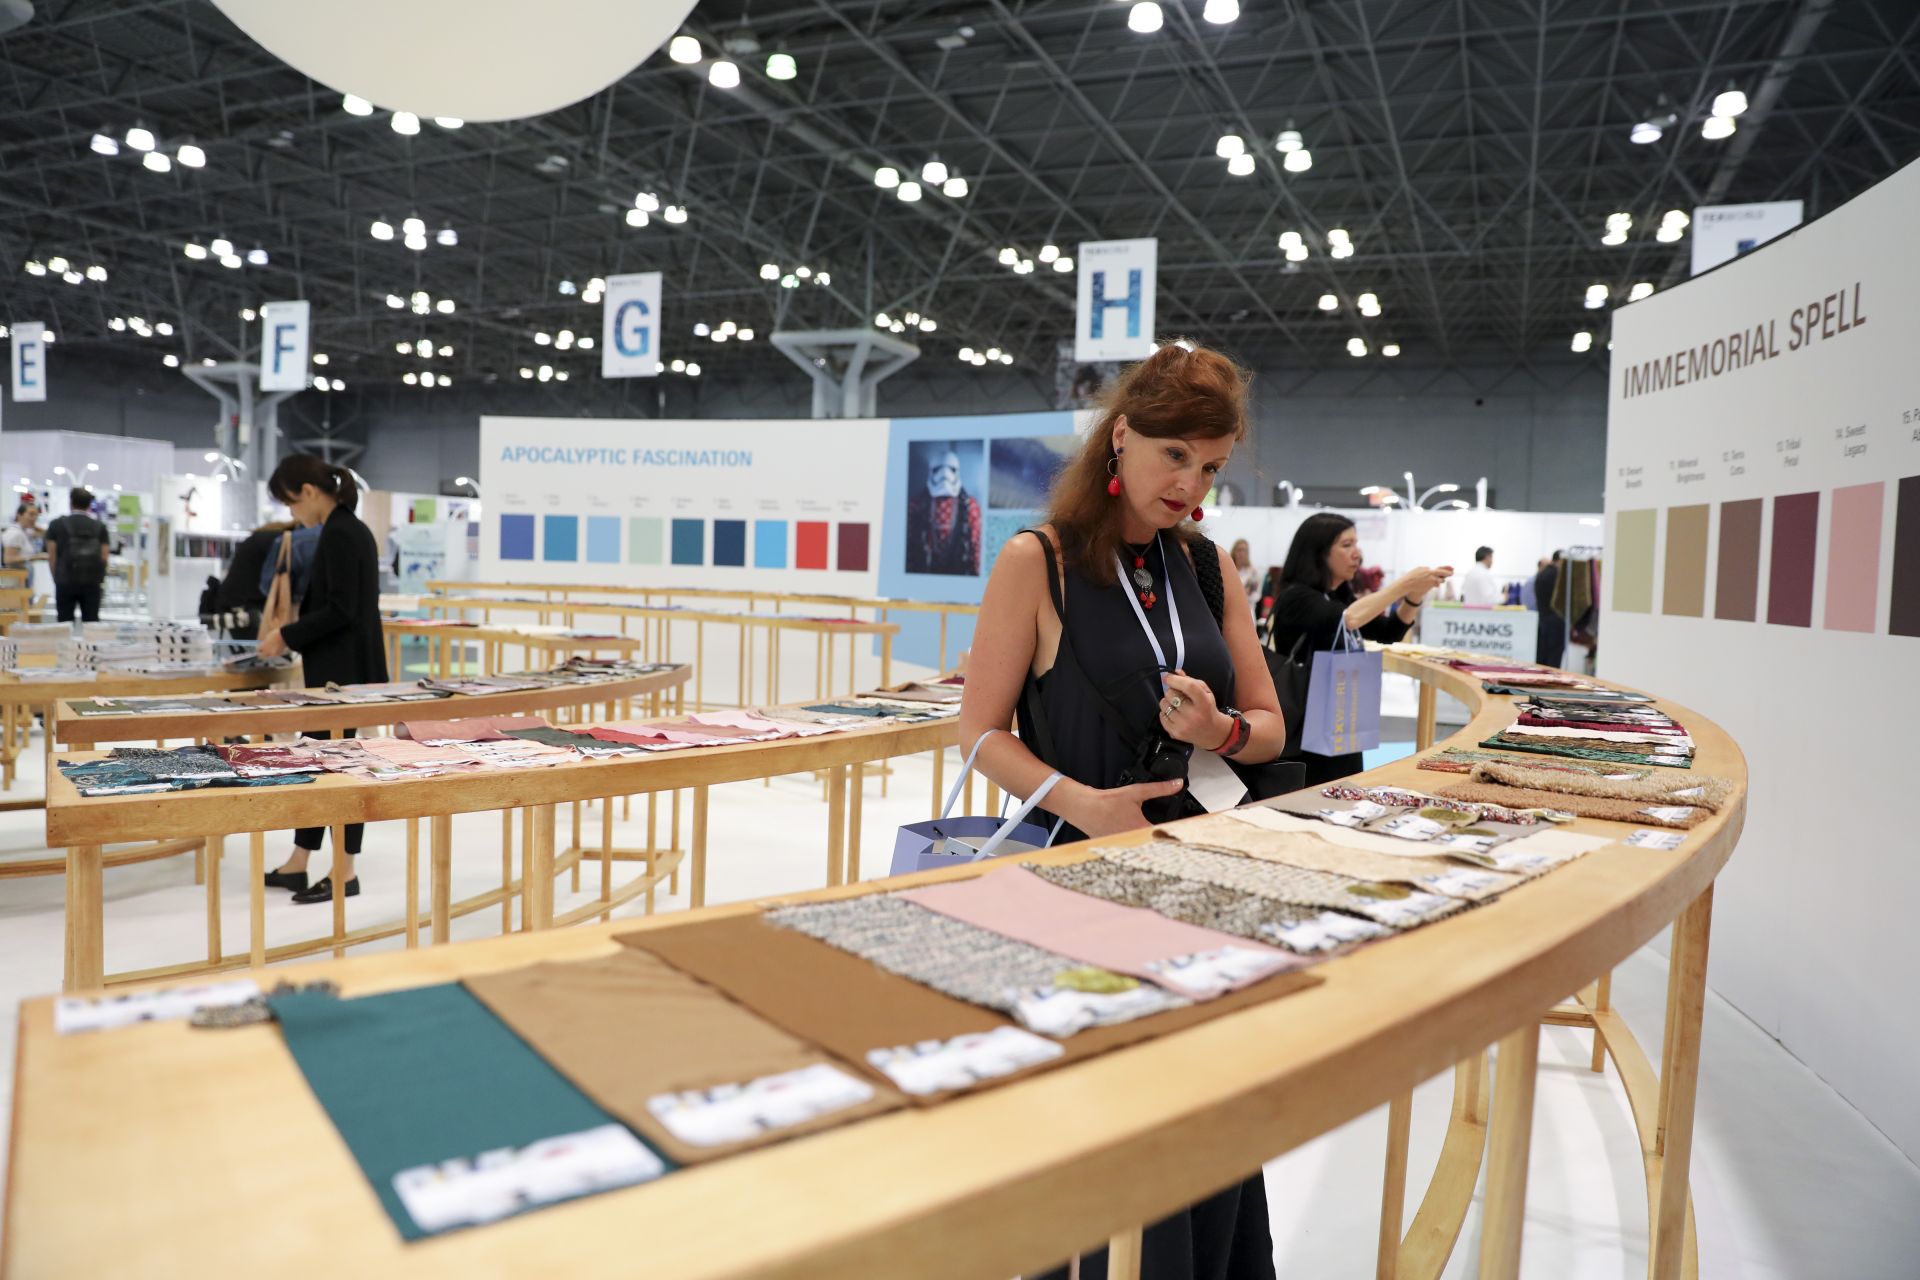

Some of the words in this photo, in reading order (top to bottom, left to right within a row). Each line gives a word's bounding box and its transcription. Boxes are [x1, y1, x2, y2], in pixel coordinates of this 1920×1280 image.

[614, 299, 650, 358] G
[1090, 268, 1142, 339] H
[19, 342, 37, 387] E
[273, 324, 298, 375] F
[1623, 319, 1779, 399] IMMEMORIAL
[1789, 282, 1867, 351] SPELL
[501, 446, 627, 465] APOCALYPTIC
[632, 448, 753, 467] FASCINATION
[1444, 621, 1513, 637] THANKS
